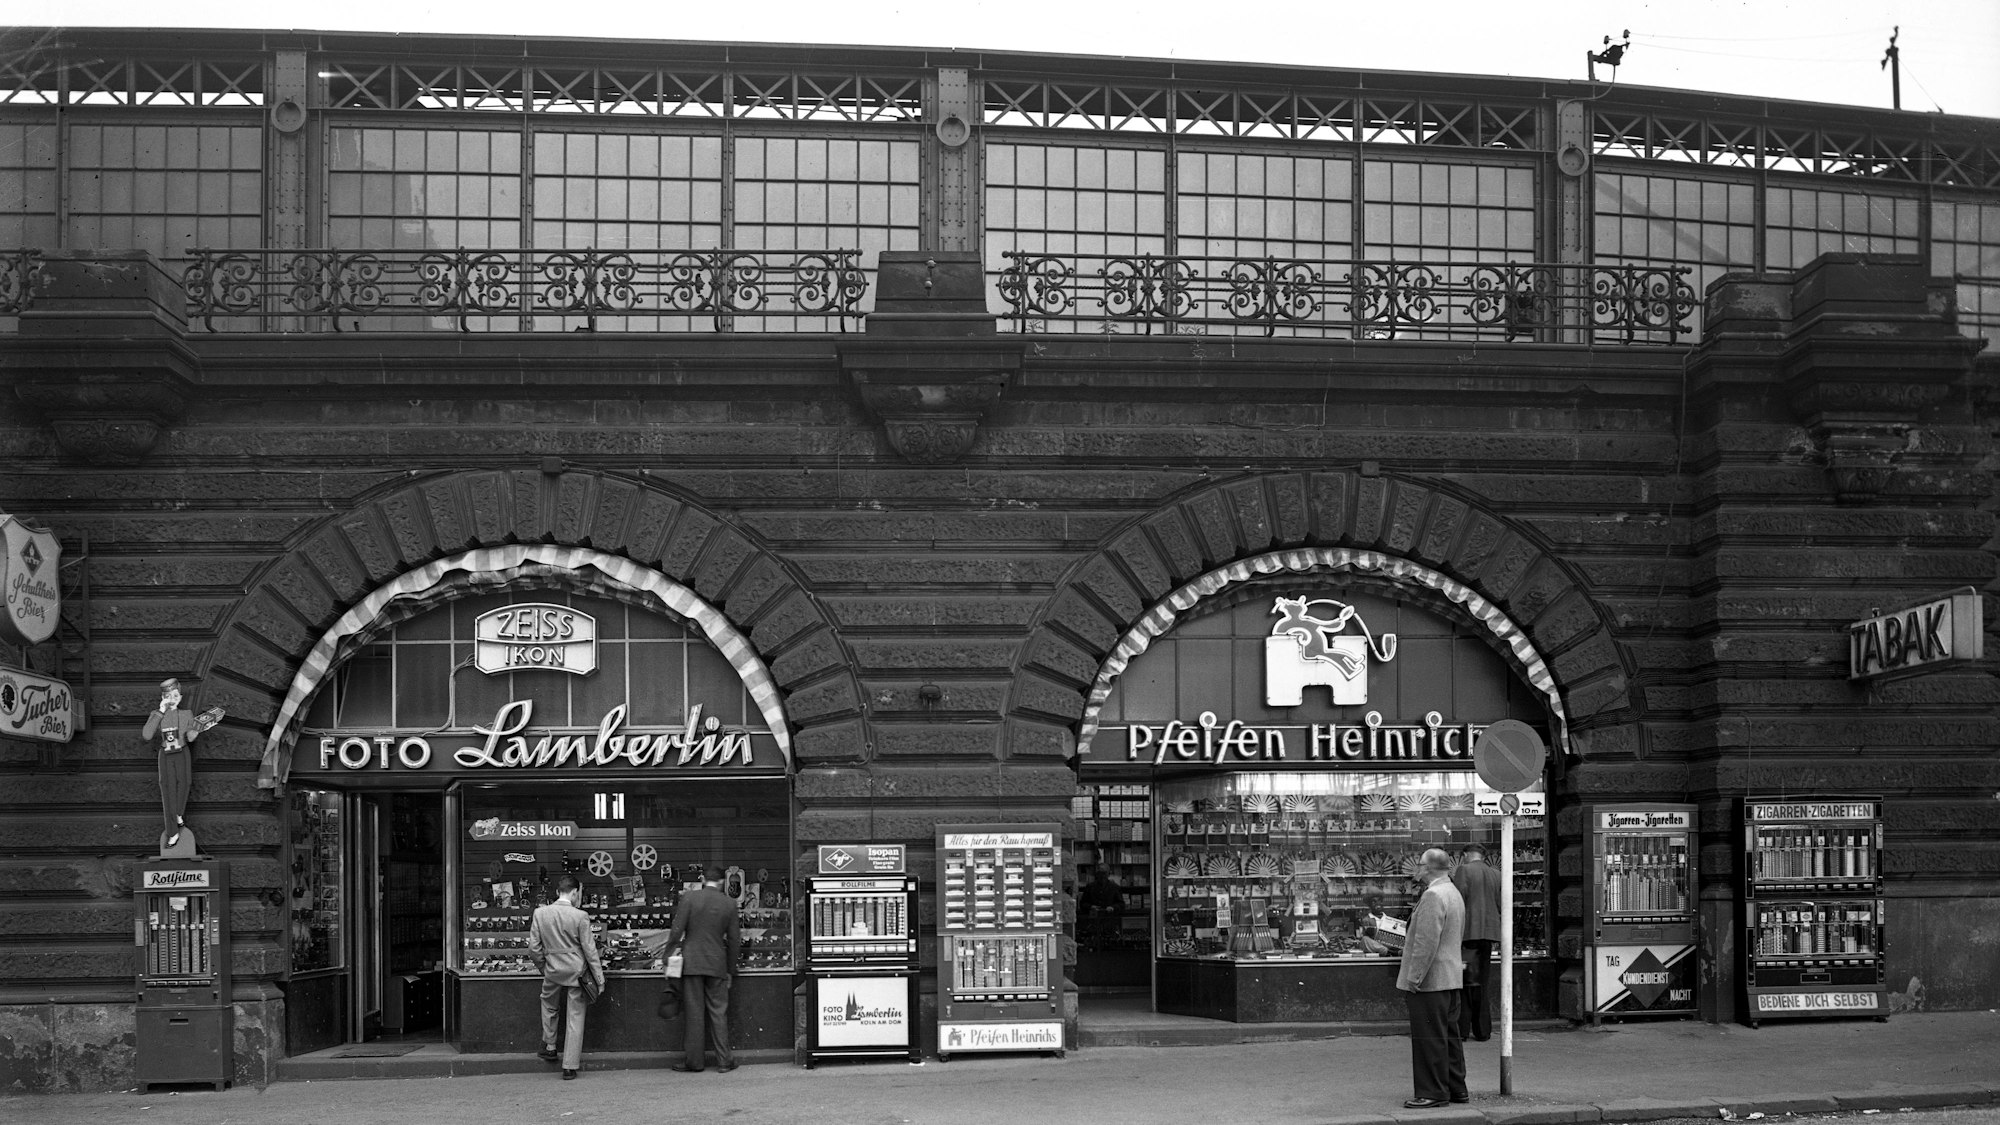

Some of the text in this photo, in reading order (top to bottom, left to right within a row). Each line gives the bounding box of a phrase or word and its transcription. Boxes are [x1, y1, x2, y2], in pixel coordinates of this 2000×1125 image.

[17, 597, 46, 623] Bier
[497, 609, 574, 639] ZEISS
[1851, 603, 1949, 674] TABAK
[505, 645, 565, 666] IKON
[11, 684, 70, 729] Tucher
[40, 716, 67, 739] Bier
[319, 699, 753, 769] FOTO Lambertin
[1129, 711, 1286, 765] Pfeifen
[1756, 804, 1871, 819] ZIGARREN-ZIGARETTEN
[500, 822, 572, 837] Zeiss Ikon
[948, 834, 1050, 847] Alles für den Rauchgenuß
[828, 853, 850, 867] Agfa
[868, 847, 900, 857] Isopan
[148, 871, 206, 887] Rollfilme
[1606, 955, 1620, 968] TAG
[1622, 971, 1670, 985] KUNDENDIENST
[1670, 988, 1692, 1001] NACHT
[1760, 993, 1874, 1009] BEDIENE DICH SELBST
[970, 1028, 1057, 1046] Pfeifen Heinrichs
